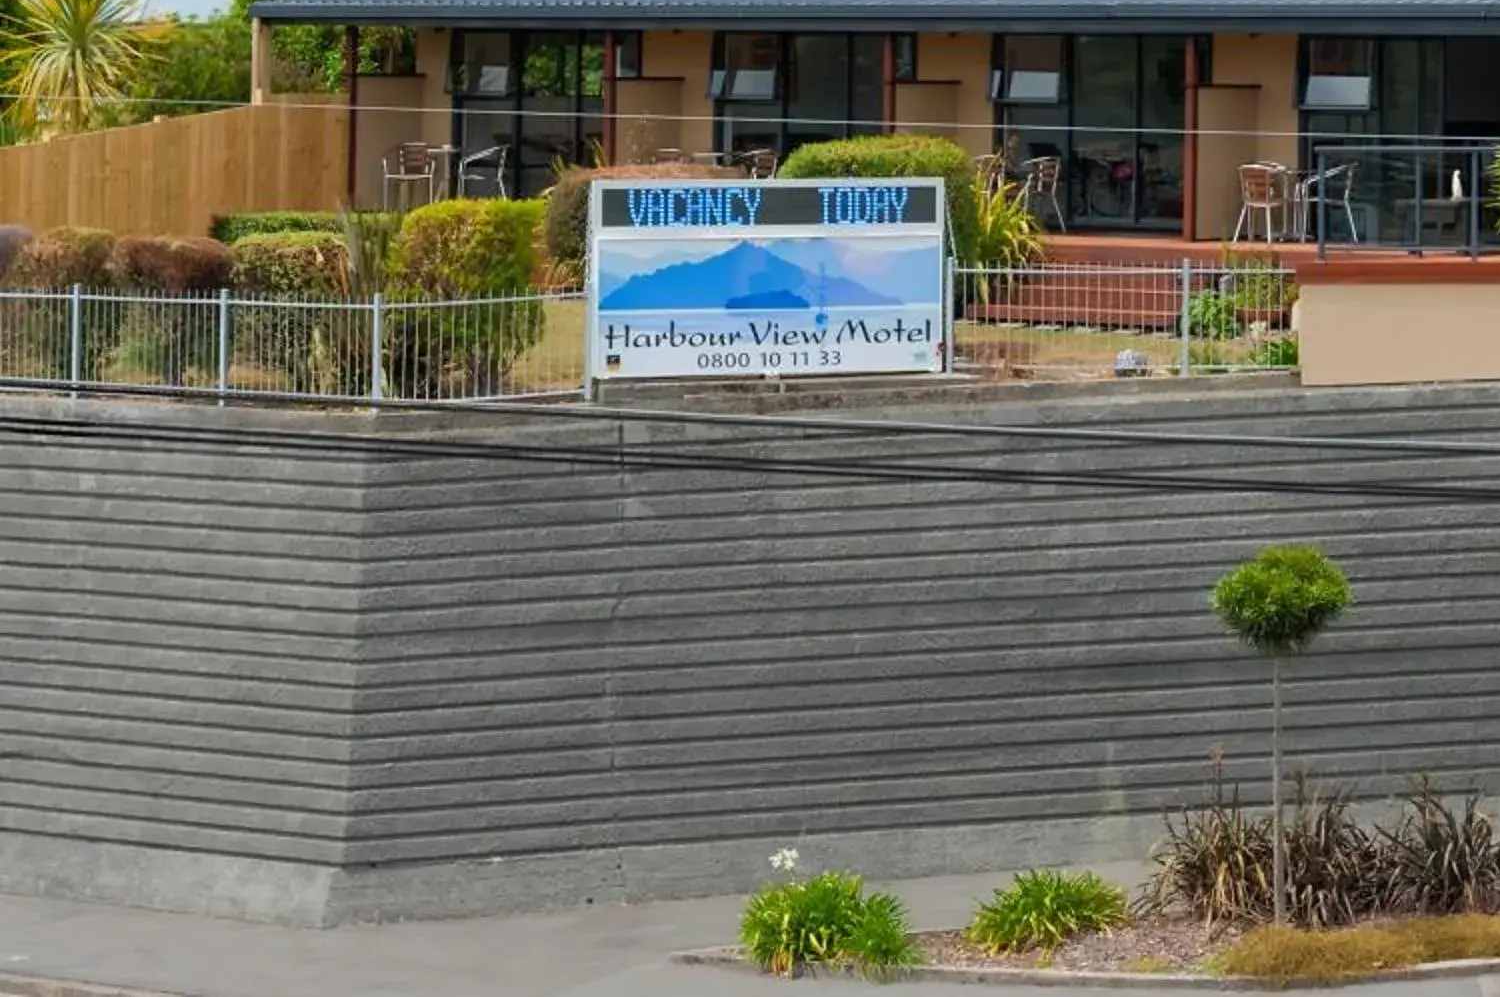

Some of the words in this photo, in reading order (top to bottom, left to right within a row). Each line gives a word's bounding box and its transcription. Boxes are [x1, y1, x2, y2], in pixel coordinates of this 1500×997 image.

[628, 187, 763, 227] VACANCY
[818, 187, 909, 224] TODAY
[605, 319, 742, 349] Harbour
[748, 320, 828, 345] View
[834, 317, 932, 344] Motel
[697, 352, 751, 368] 0800
[761, 352, 781, 367] 10
[790, 351, 810, 366] 11
[819, 350, 842, 366] 33
